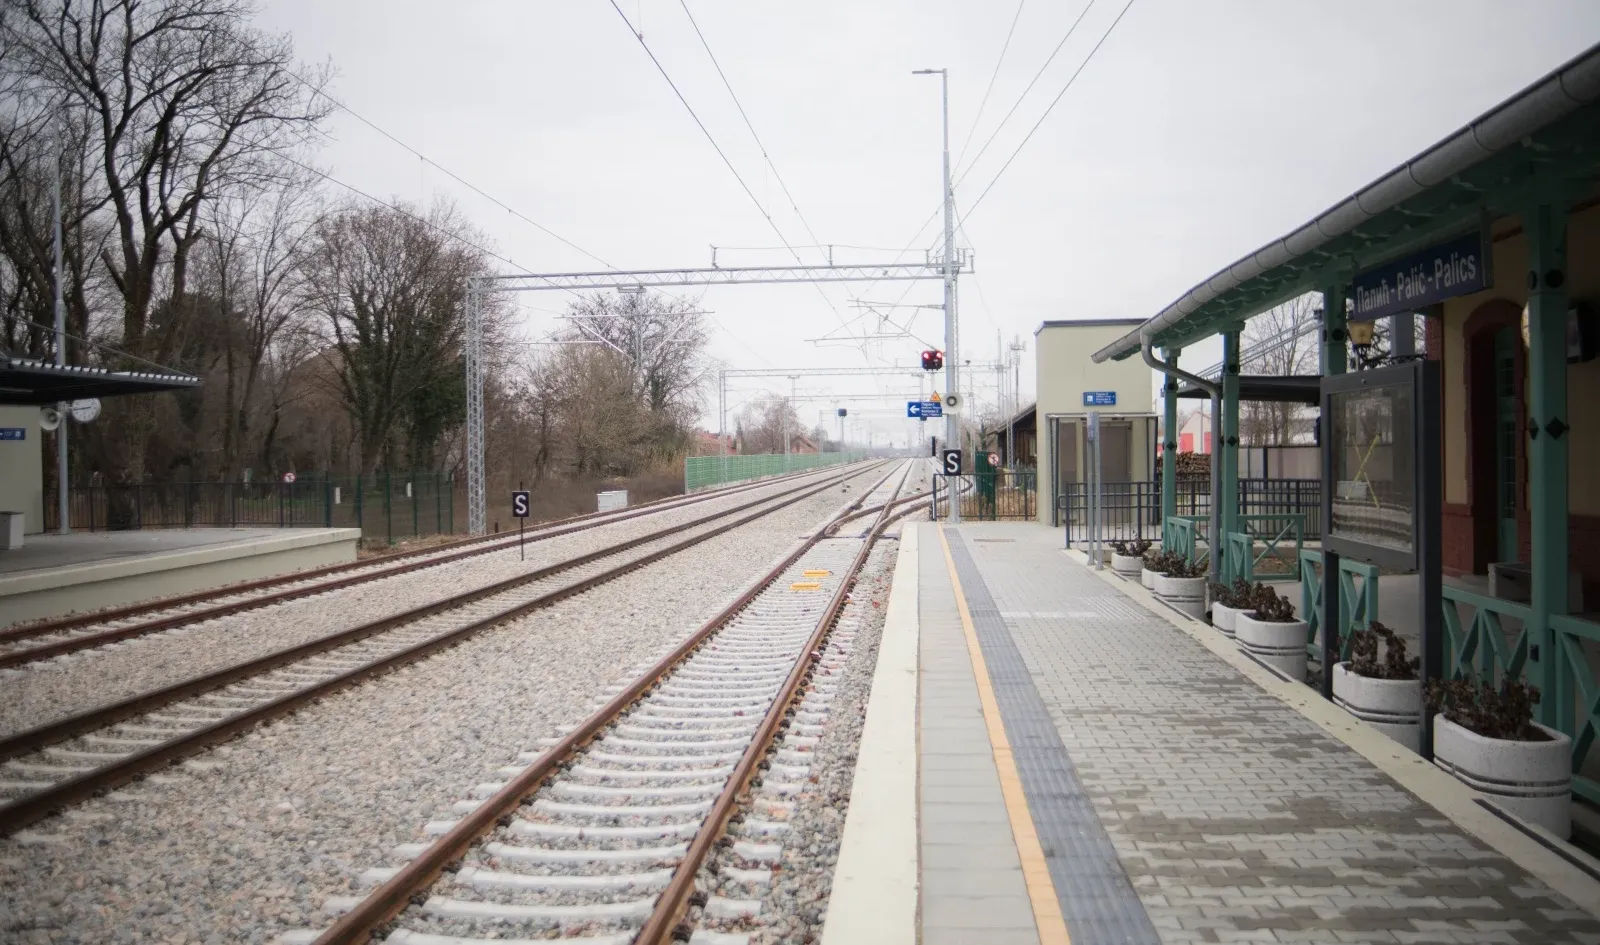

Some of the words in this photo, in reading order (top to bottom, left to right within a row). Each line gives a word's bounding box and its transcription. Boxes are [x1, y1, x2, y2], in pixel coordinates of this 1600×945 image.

[1397, 263, 1426, 301] Palić
[1434, 252, 1476, 290] Palics
[946, 452, 959, 473] S
[515, 494, 527, 514] S
